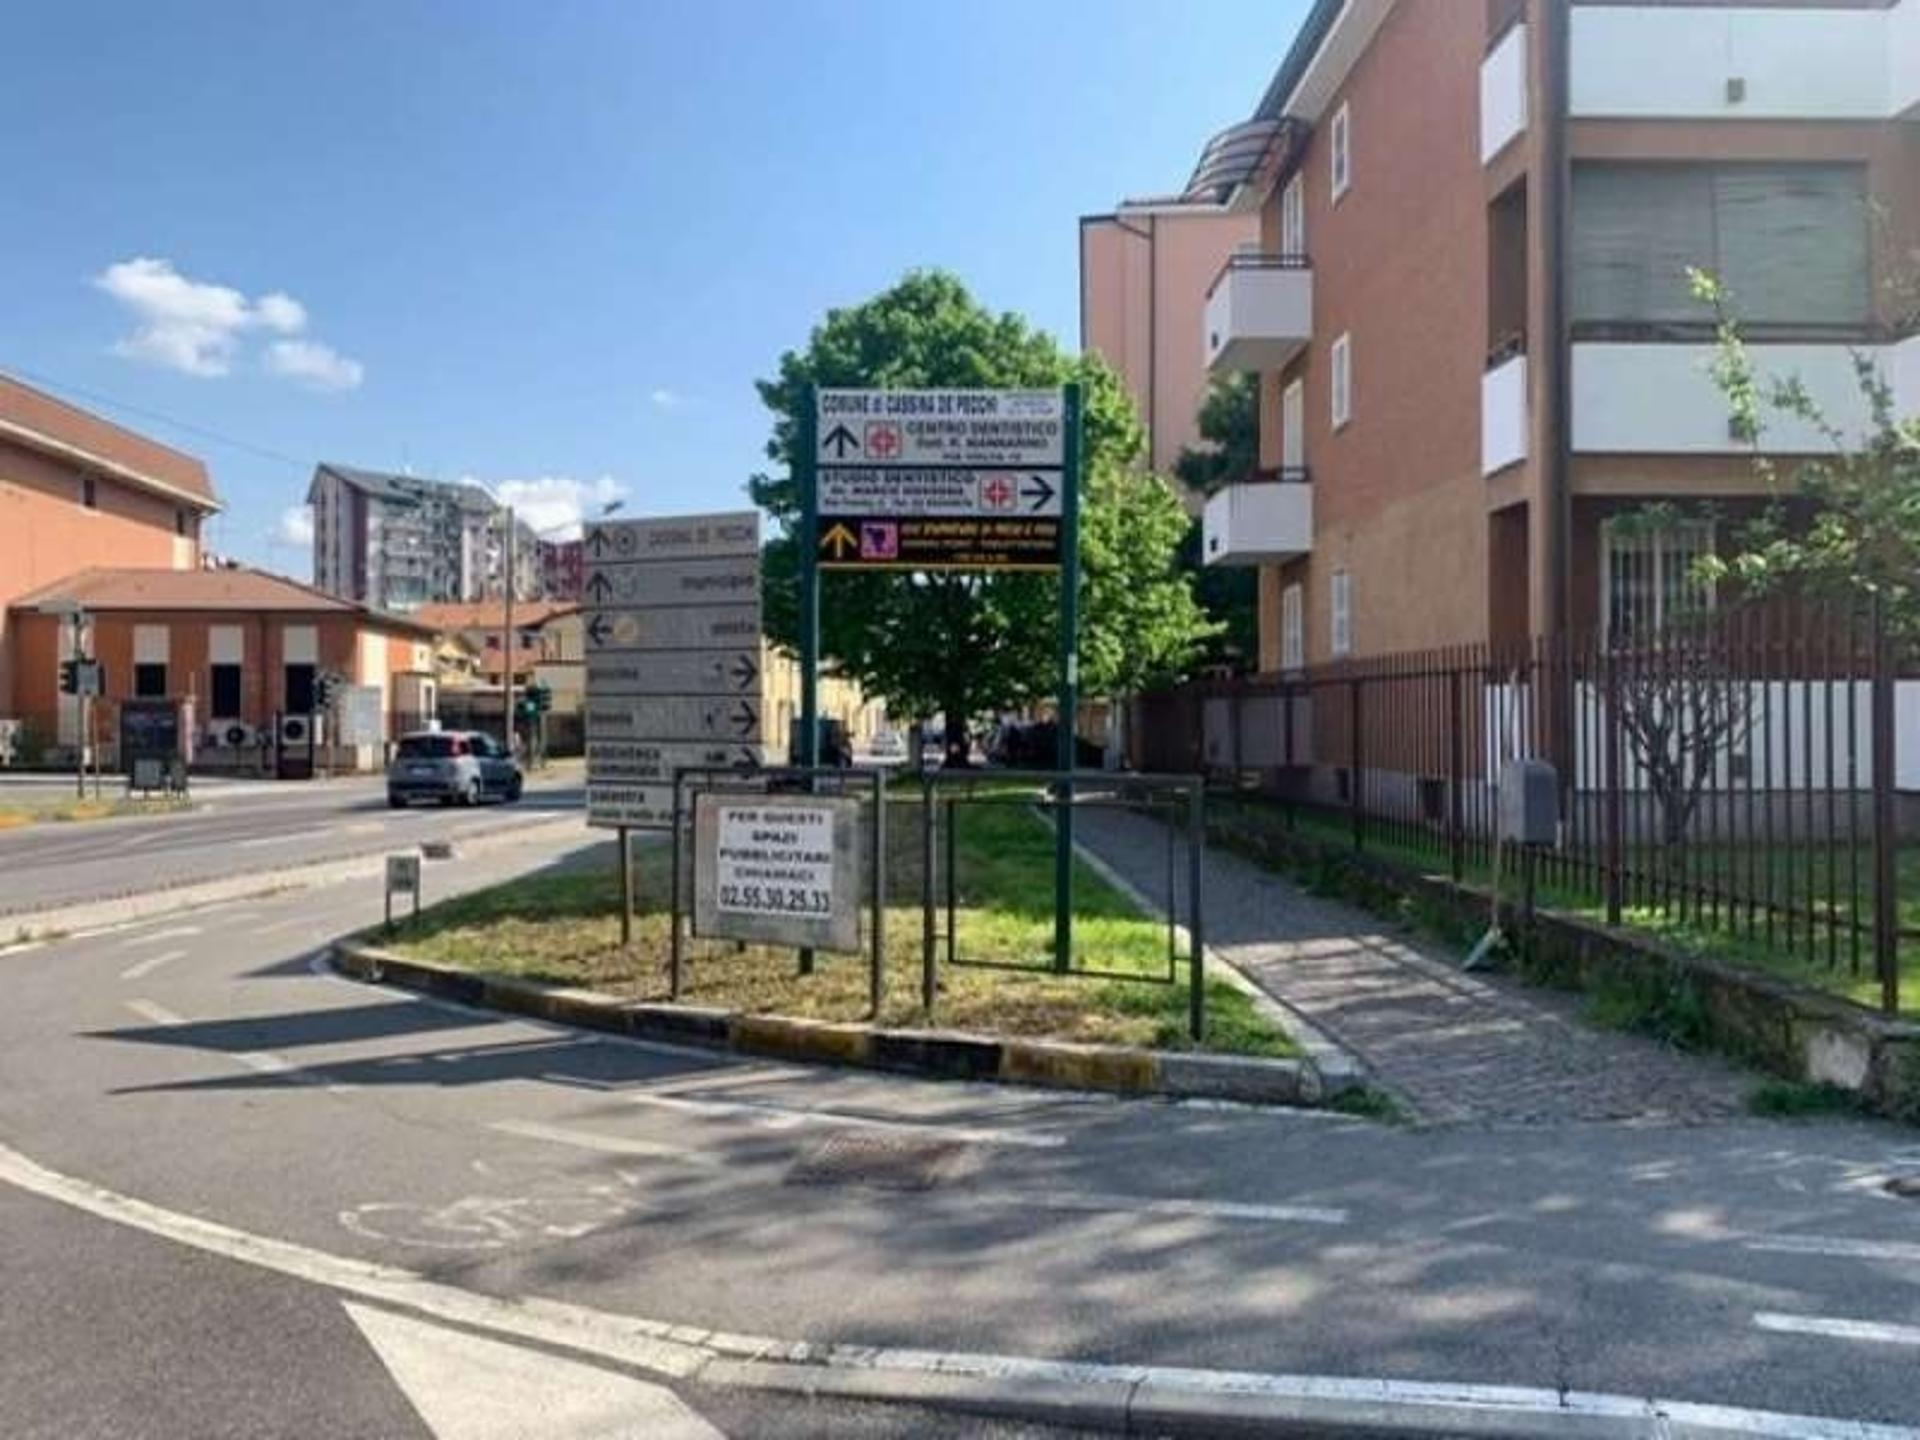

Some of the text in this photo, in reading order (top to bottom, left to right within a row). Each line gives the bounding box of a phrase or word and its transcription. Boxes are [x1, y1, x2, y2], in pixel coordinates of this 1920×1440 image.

[905, 420, 1058, 437] CENTRO DENTISTICO
[728, 811, 823, 825] PER QUESTI
[752, 830, 798, 844] SPAZI
[719, 848, 830, 863] PUBBLICITARI
[734, 867, 815, 881] CHIAMACI
[720, 885, 830, 913] 02.55.30.25.33
